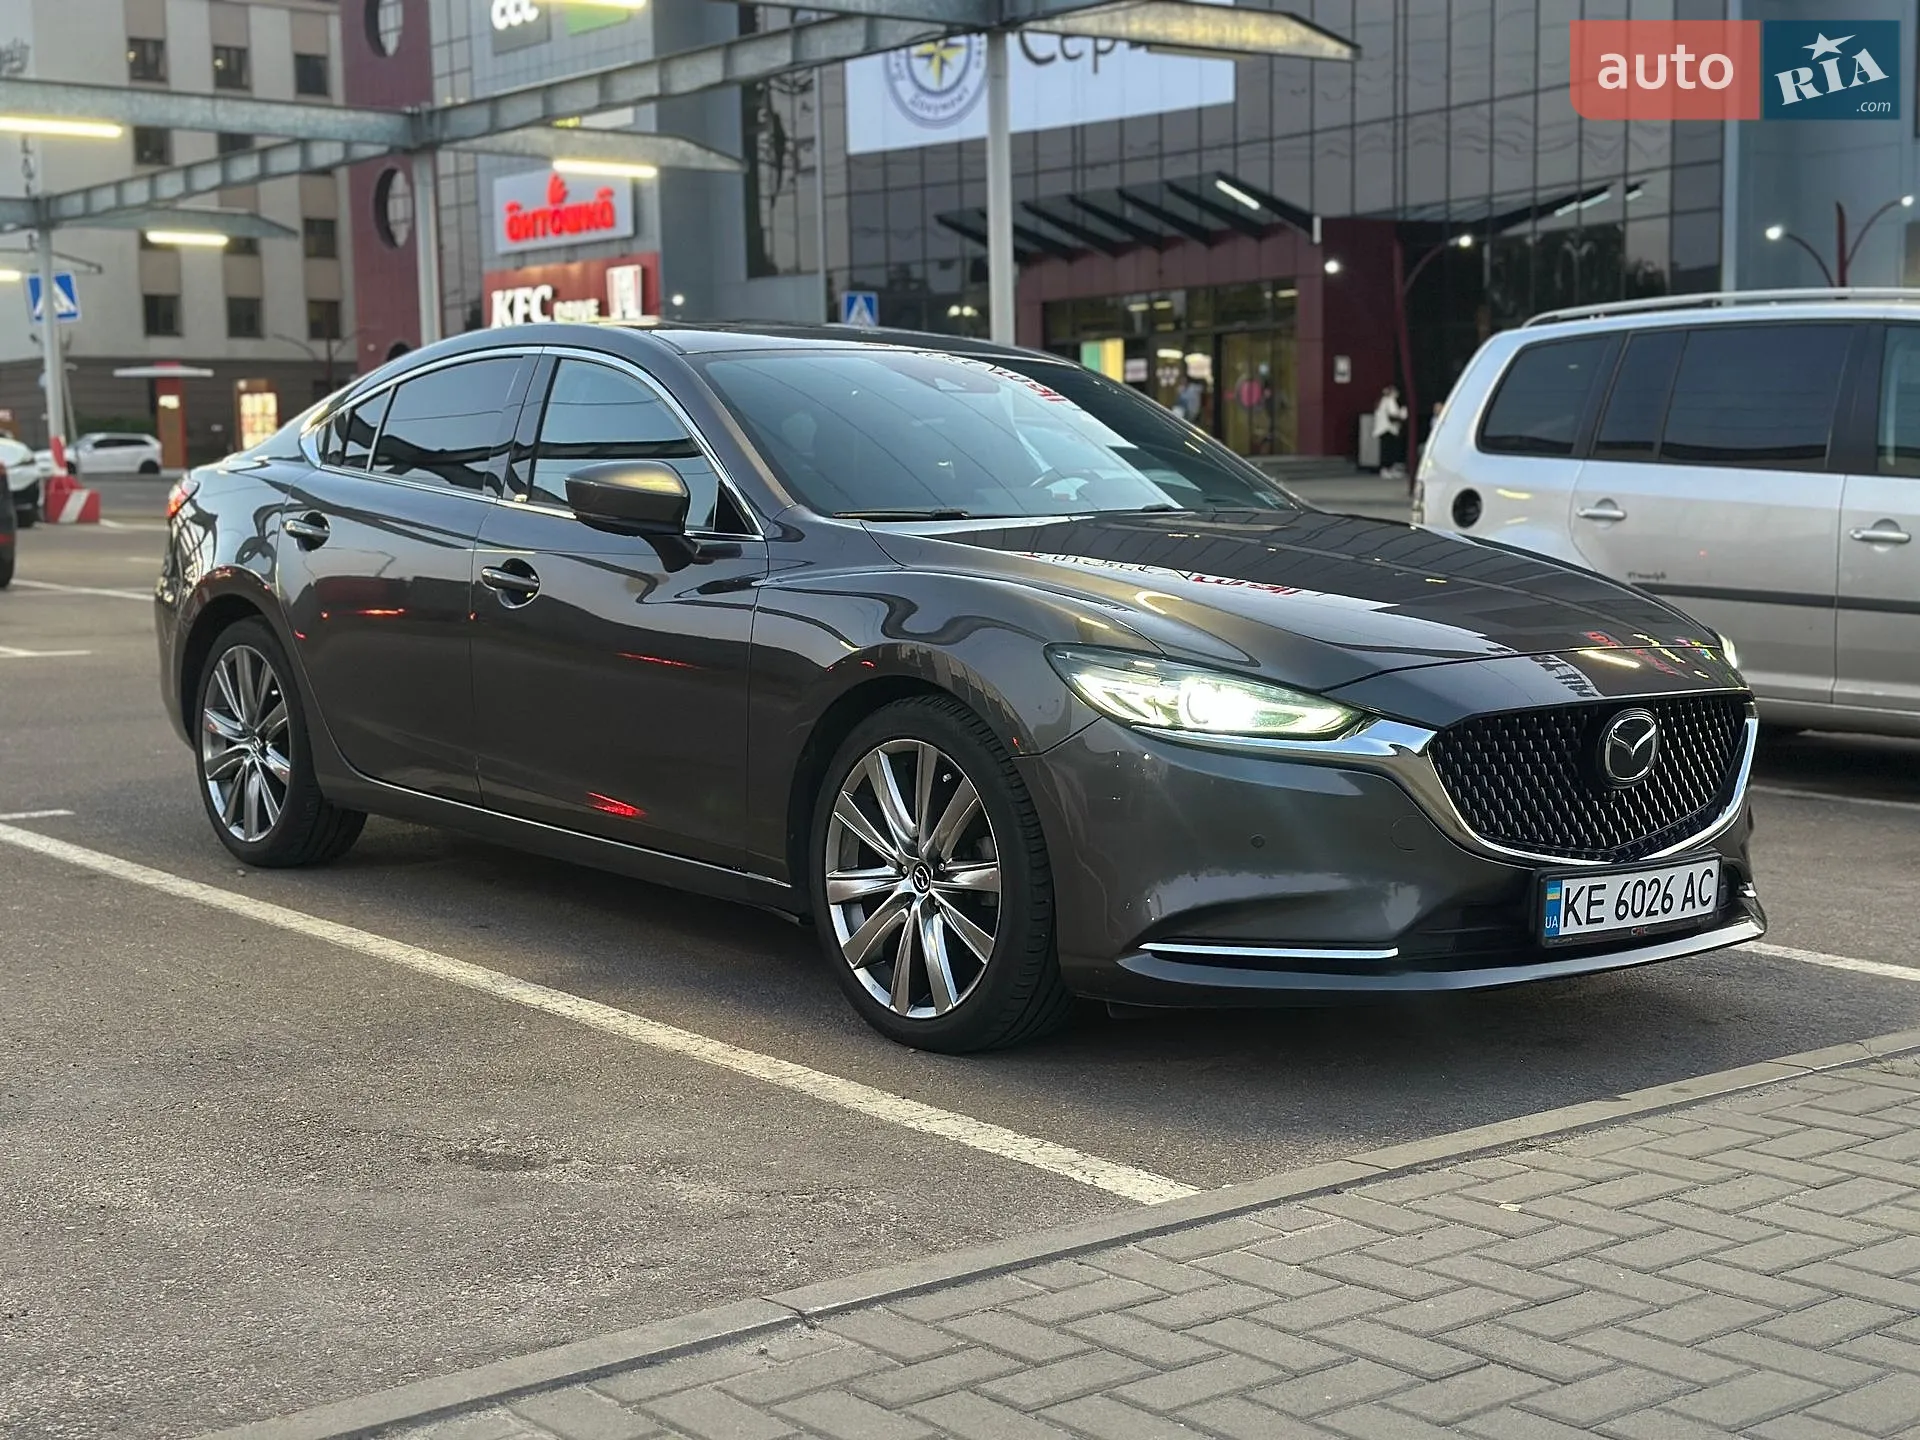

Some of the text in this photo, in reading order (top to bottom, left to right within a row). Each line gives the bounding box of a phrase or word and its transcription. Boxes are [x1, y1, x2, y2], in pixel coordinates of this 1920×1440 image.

[491, 284, 553, 329] KFC
[1563, 868, 1714, 928] KE 6026 AC
[1545, 915, 1558, 929] UA
